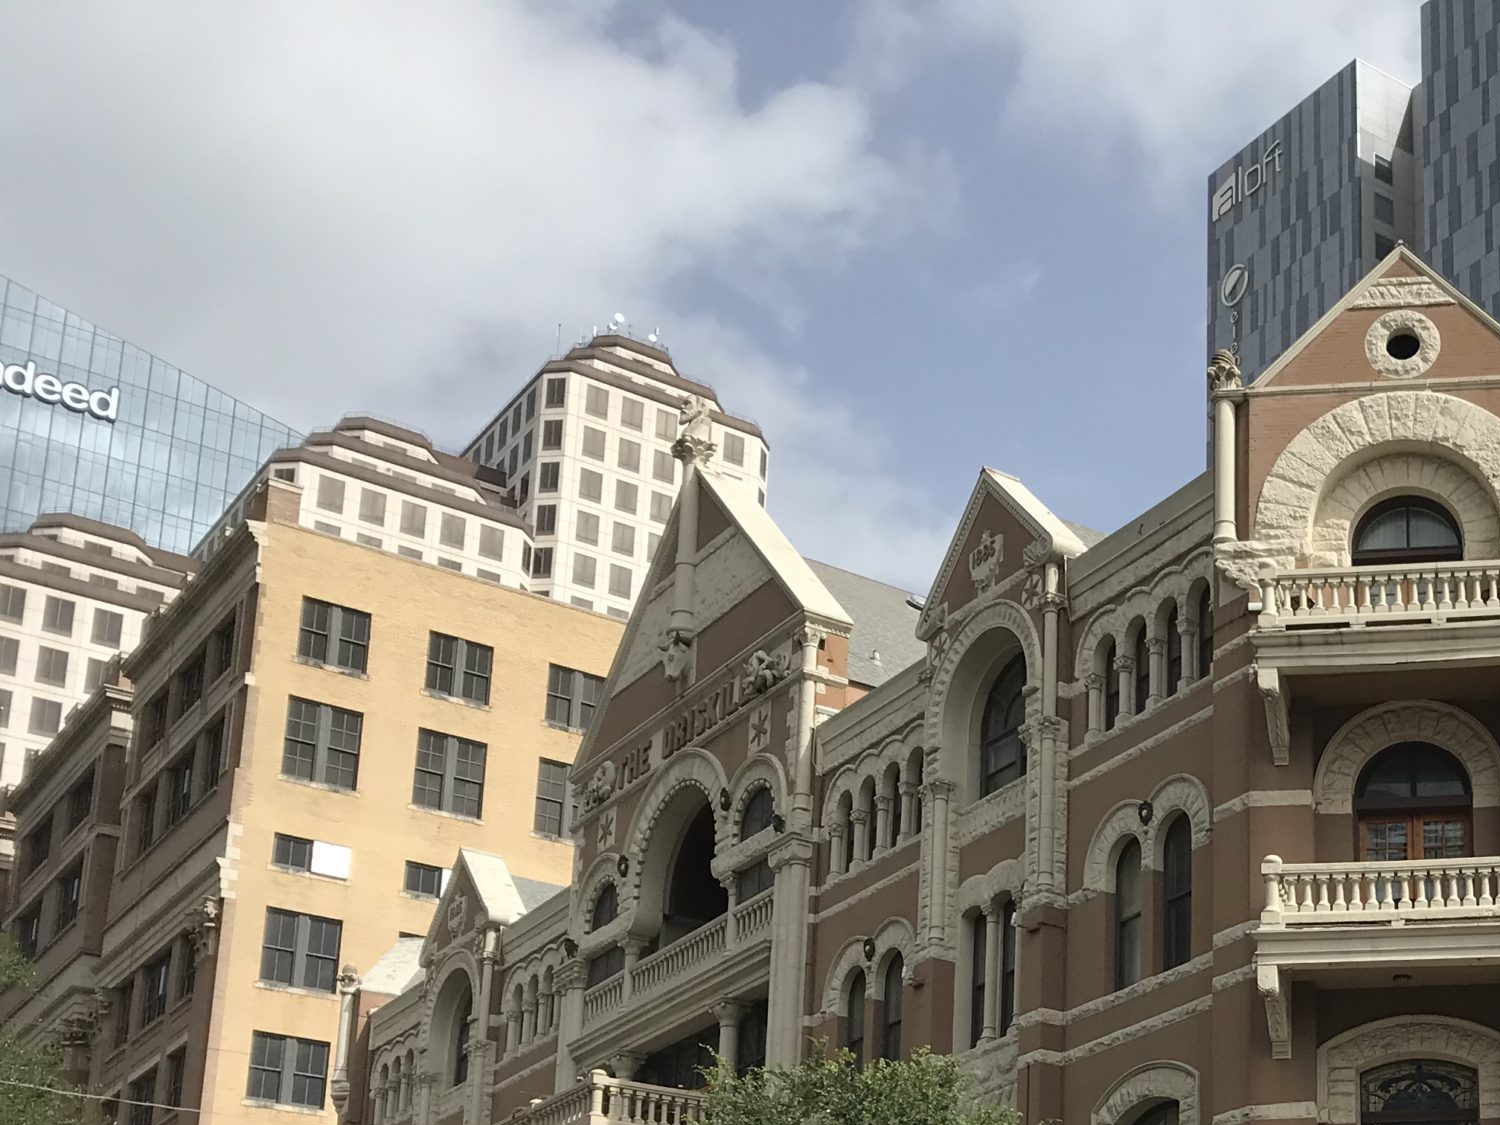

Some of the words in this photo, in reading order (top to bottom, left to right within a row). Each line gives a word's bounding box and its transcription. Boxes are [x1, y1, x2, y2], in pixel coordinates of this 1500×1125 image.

[1212, 139, 1282, 222] aloft
[972, 539, 996, 570] 1885
[617, 739, 652, 790] THE
